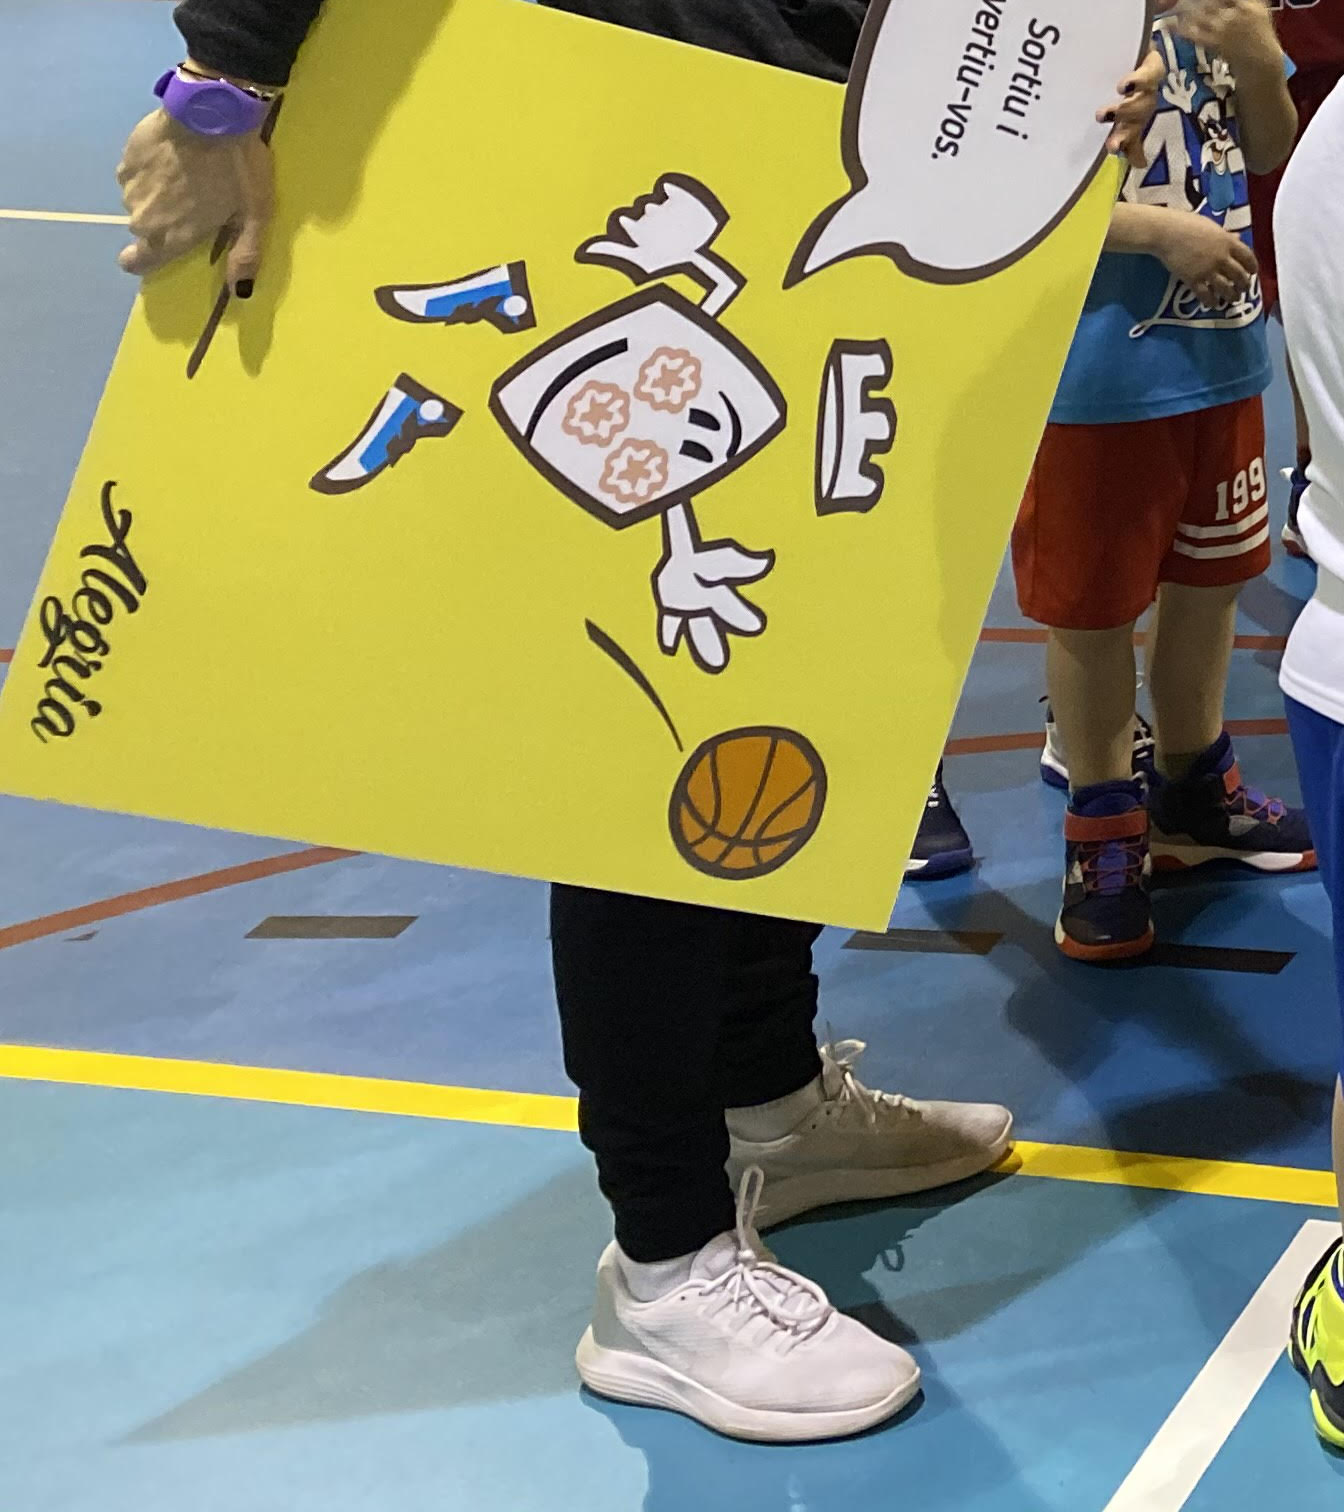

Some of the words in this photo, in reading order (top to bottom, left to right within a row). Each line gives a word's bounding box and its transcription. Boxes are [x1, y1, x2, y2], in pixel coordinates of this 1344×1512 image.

[1003, 17, 1061, 119] Sortiu
[995, 122, 1028, 141] i
[30, 480, 147, 744] Alegria
